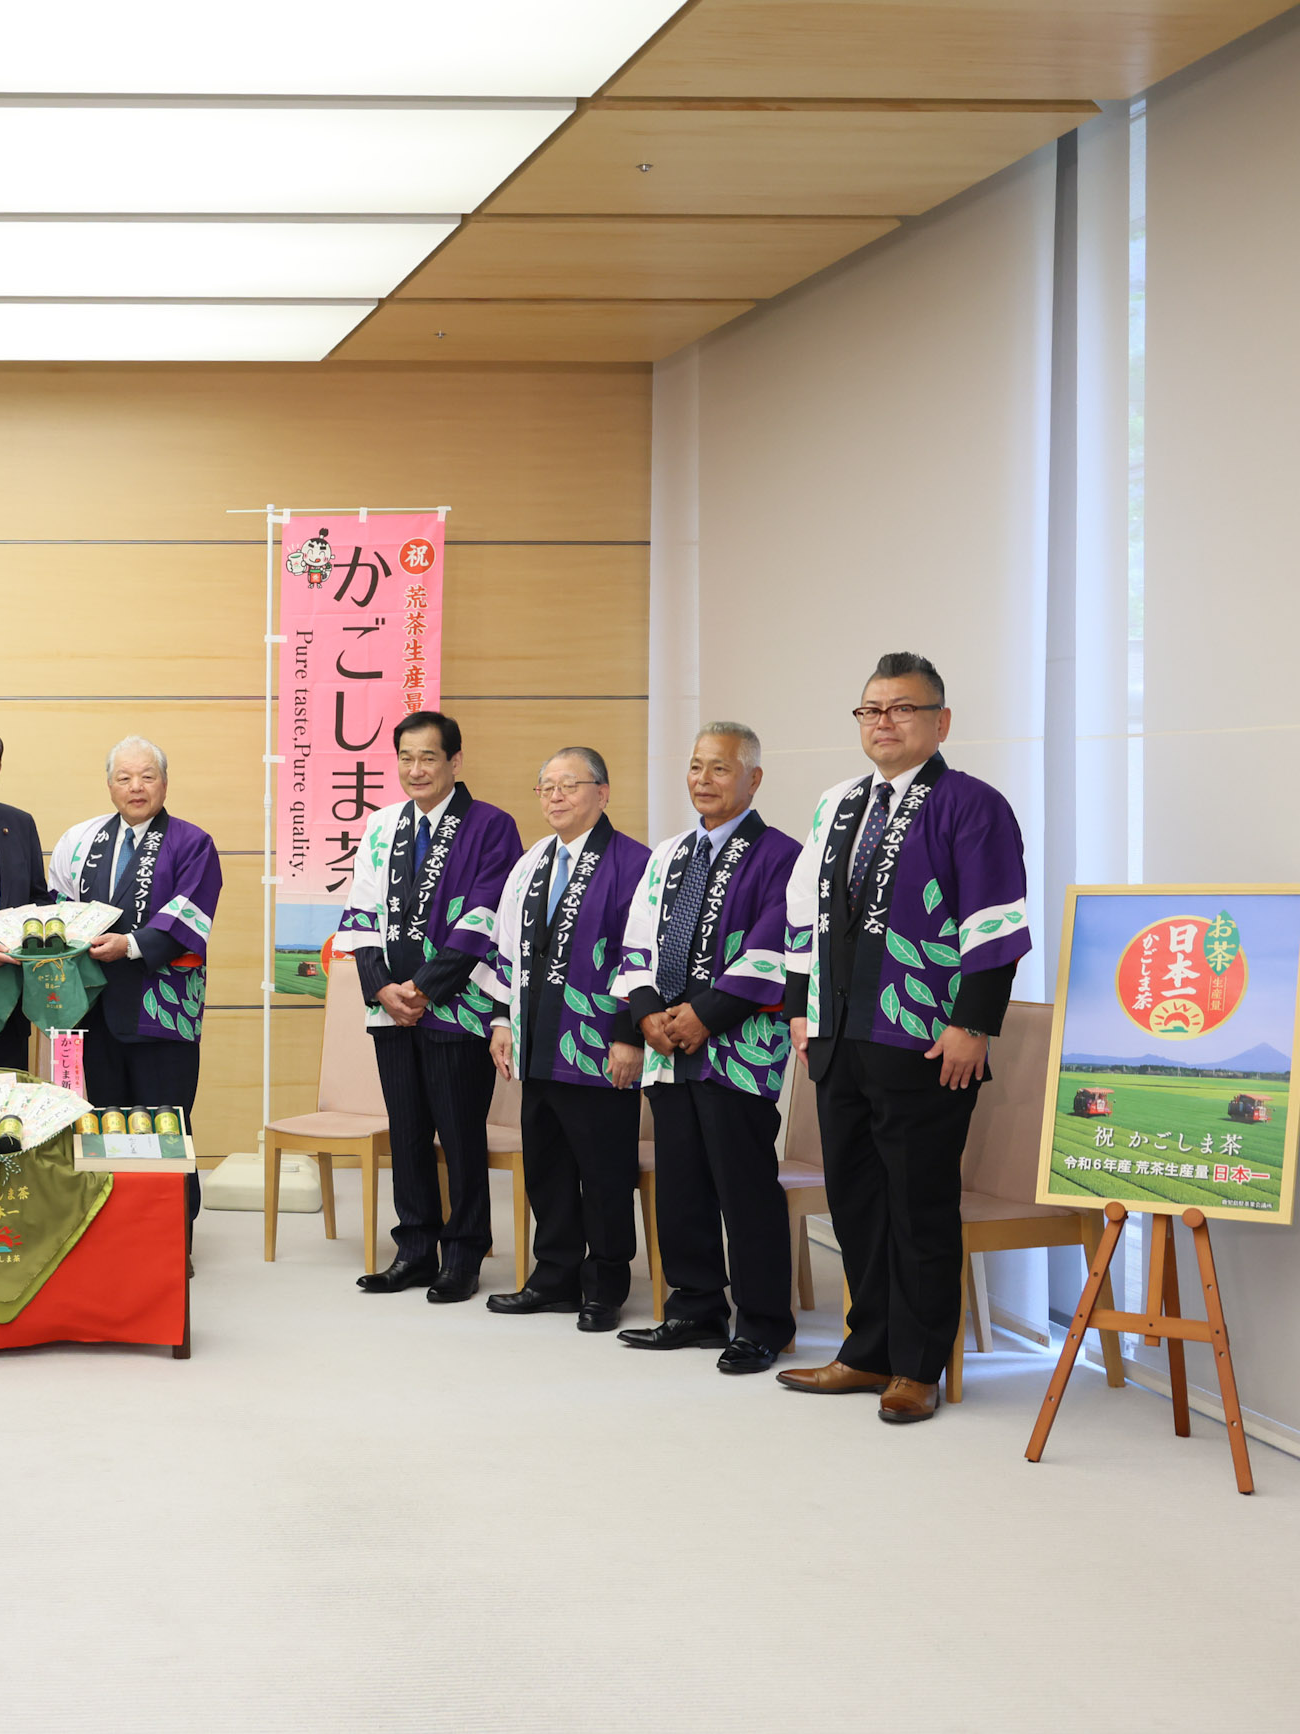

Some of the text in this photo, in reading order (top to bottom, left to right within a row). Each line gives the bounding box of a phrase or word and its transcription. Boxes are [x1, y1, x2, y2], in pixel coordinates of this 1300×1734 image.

[404, 544, 429, 568] 祝
[294, 629, 313, 679] Pure
[289, 801, 310, 877] quality.
[818, 786, 864, 934] かごしま茶
[863, 783, 932, 936] 安全・安心でクリーンな
[387, 815, 410, 942] かごしま茶
[406, 814, 461, 941] 安全・安心でクリーンな
[692, 837, 751, 981] 安全・安心でクリーンな
[520, 854, 549, 988] かごしま茶
[547, 851, 600, 986] 安全・安心でクリーンな
[1206, 914, 1237, 972] お茶
[1132, 933, 1160, 1010] かごしま茶
[1160, 923, 1201, 998] 日本一
[1211, 976, 1224, 1011] 生産量
[1064, 1155, 1271, 1184] 令和6年産 荒茶生産量 日本一
[1094, 1126, 1243, 1156] 祝 かごしま茶
